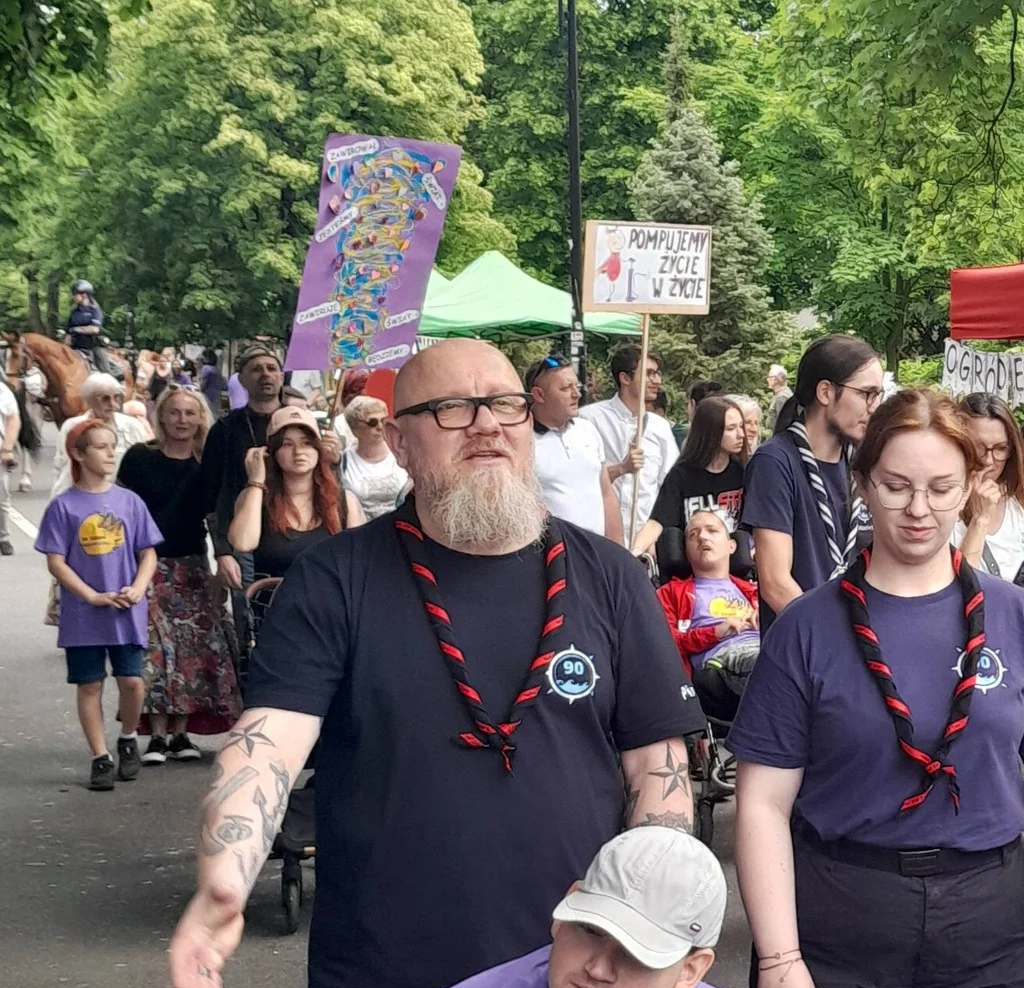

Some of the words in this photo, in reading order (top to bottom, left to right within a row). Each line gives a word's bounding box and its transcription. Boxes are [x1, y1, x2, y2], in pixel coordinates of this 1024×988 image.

[628, 228, 708, 253] POMPUJEMY
[658, 251, 700, 275] ŻYCIE
[652, 277, 664, 298] W
[669, 275, 706, 299] ŻYCIE
[563, 660, 584, 675] 90
